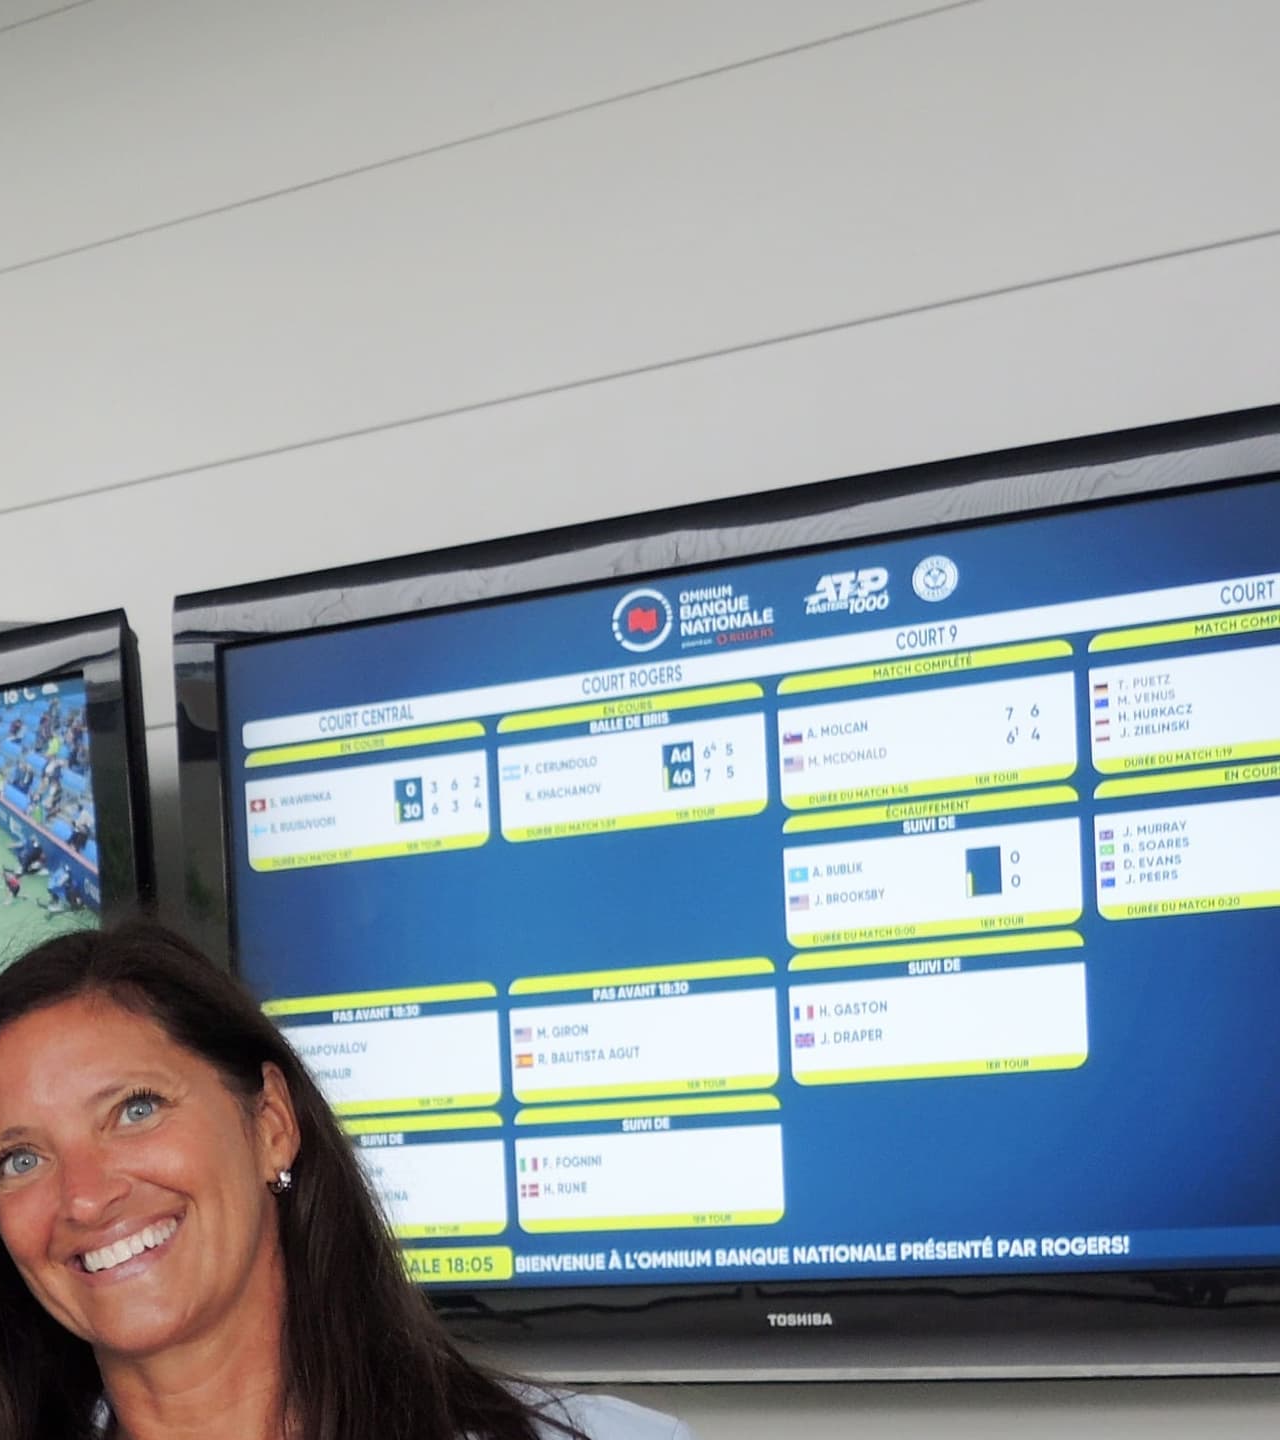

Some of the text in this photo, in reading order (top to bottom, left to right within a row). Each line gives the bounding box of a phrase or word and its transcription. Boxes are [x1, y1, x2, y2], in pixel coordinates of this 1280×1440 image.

[679, 584, 732, 604] OMNIUM
[804, 568, 888, 603] ATP
[1220, 580, 1274, 605] COURT
[680, 595, 749, 620] BANQUE
[849, 590, 889, 615] 1000
[680, 607, 774, 636] NATIONALE
[1194, 611, 1280, 636] MATCH COMP
[896, 624, 958, 650] COURT 9
[873, 653, 973, 680] MATCH COMPLÉTÉ
[582, 664, 683, 695] COURT ROGERS
[1133, 674, 1172, 688] PUETZ
[1134, 689, 1176, 705] VENUS
[603, 700, 653, 716] EN COURS
[1118, 704, 1193, 724] H. HURKACZ
[319, 704, 414, 733] COURT CENTRAL
[590, 711, 669, 734] BALLE DE BRIS
[820, 720, 869, 738] MOLCAN
[1005, 707, 1013, 721] 7
[1030, 704, 1039, 718] 6
[1134, 719, 1190, 737] ZIELINSKI
[823, 747, 887, 767] MCDONALD
[1031, 727, 1040, 742] 4
[536, 756, 597, 775] CERUNDOLO
[671, 747, 690, 764] Ad
[726, 743, 734, 756] 5
[1158, 754, 1174, 765] DU
[1175, 750, 1213, 763] MATCH
[993, 772, 1019, 784] TOUR
[1224, 764, 1280, 781] EN COUR
[280, 776, 481, 808] WAWRINKA 0 3 6 2
[537, 784, 601, 801] KHACHANOV
[672, 771, 690, 786] 40
[704, 769, 712, 782] 7
[726, 766, 734, 778] 5
[840, 789, 854, 801] DU
[856, 786, 889, 801] MATCH
[403, 803, 421, 820] 30
[431, 802, 439, 815] 6
[451, 801, 459, 813] 3
[474, 797, 482, 810] 4
[692, 807, 715, 818] TOUR
[885, 799, 970, 820] ÉCHAUFFEMENT
[568, 820, 597, 834] MATCH
[903, 815, 956, 834] SUIVI DE
[1137, 820, 1187, 836] MURRAY
[1138, 837, 1190, 853] SOARES
[826, 861, 863, 878] BUBLIK
[1010, 851, 1020, 864] 0
[1124, 854, 1182, 870] D. EVANS
[1139, 869, 1179, 884] PEERS
[826, 888, 885, 905] BROOKSBY
[1011, 874, 1021, 888] 0
[1161, 902, 1178, 912] DU
[1179, 898, 1216, 911] MATCH
[997, 916, 1024, 927] TOUR
[844, 928, 858, 942] DU
[859, 926, 893, 941] MATCH
[908, 958, 961, 976] SUIVI DE
[593, 981, 689, 1001] PAS AVANT 18:30
[332, 1003, 420, 1024] PAS AVANT 18:30
[819, 1000, 888, 1018] H. GASTON
[552, 1024, 589, 1038] GIRON
[833, 1028, 883, 1045] DRAPER
[551, 1048, 605, 1064] BAUTISTA
[609, 1046, 640, 1059] AGUT
[1002, 1058, 1029, 1069] TOUR
[622, 1117, 670, 1132] SUIVI DE
[360, 1132, 404, 1146] SUIVI DE
[556, 1154, 602, 1169] FOGNINI
[558, 1182, 588, 1195] RUNE
[515, 1235, 1130, 1273] BIENVENUE À L'OMNIUM BANQUE NATIONALE PRÉSENTÉ PAR ROGERS!
[409, 1256, 494, 1274] ALE 18:05
[768, 1313, 832, 1327] TOSHIBA
